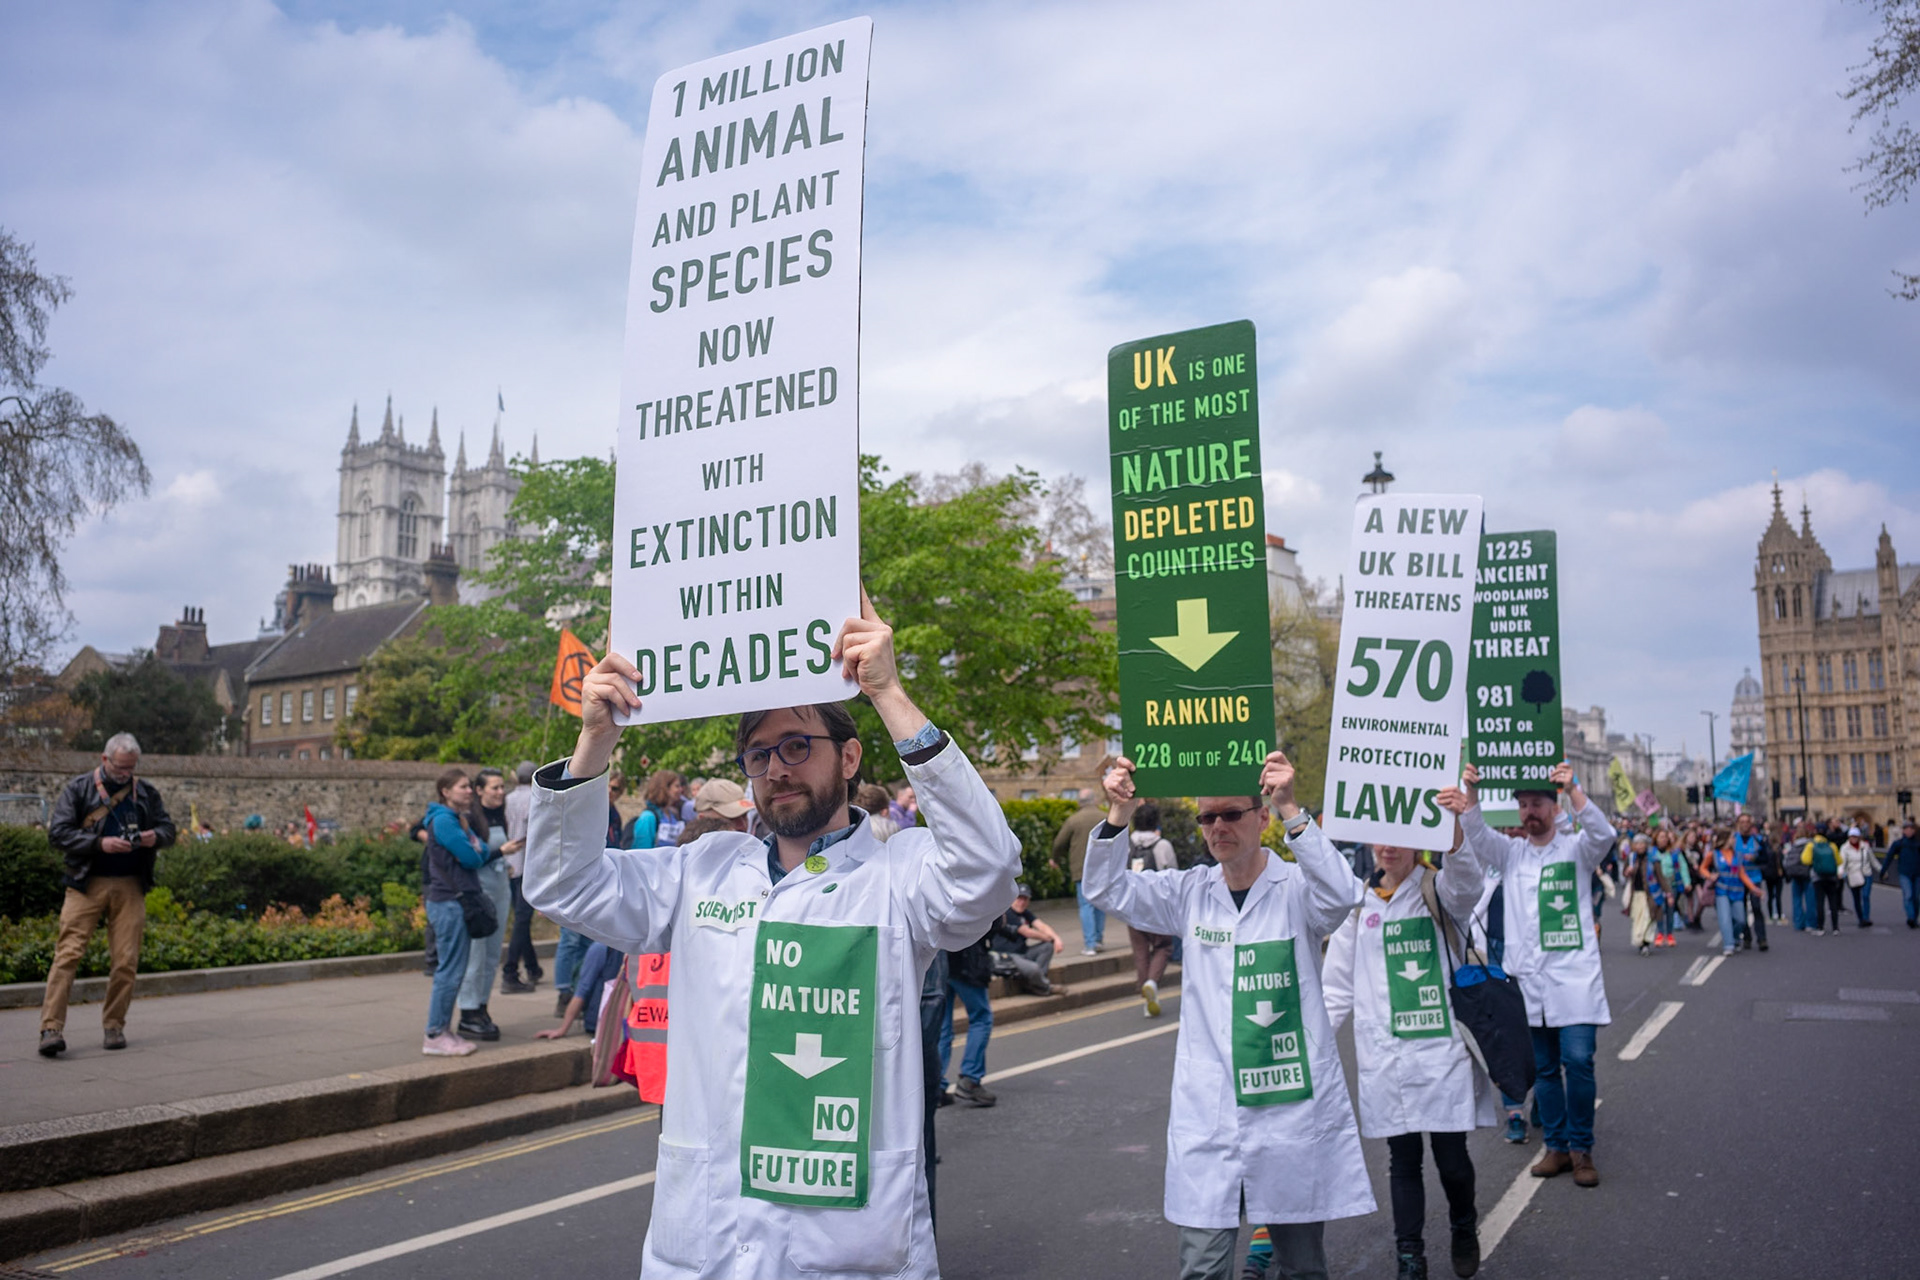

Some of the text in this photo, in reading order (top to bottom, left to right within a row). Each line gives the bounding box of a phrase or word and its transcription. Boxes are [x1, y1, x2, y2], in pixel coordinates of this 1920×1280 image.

[672, 39, 845, 118] 1 MILLION
[656, 96, 844, 188] ANIMAL
[651, 170, 840, 248] AND PLANT
[650, 229, 833, 313] SPECIES
[698, 316, 774, 368] NOW
[1134, 346, 1246, 390] UK IS ONE
[636, 366, 838, 440] THREATENED
[1119, 389, 1250, 431] OF THE MOST
[702, 453, 764, 491] WITH
[1122, 439, 1252, 495] NATURE
[630, 495, 837, 569] EXTINCTION
[1124, 496, 1255, 541] DEPLETED
[1364, 507, 1469, 535] A NEW
[1127, 541, 1255, 580] COUNTRIES
[1358, 551, 1464, 579] UK BILL
[1486, 540, 1533, 562] 1225
[1475, 563, 1549, 585] ANCIENT
[680, 572, 783, 620] WITHIN
[1354, 590, 1462, 613] THREATENS
[1492, 604, 1528, 618] IN UK
[1490, 620, 1532, 634] UNDER
[636, 619, 832, 697] DECADES
[1473, 636, 1551, 659] THREAT
[1346, 636, 1454, 702] 570
[1476, 685, 1514, 707] 981
[1145, 695, 1250, 726] RANKING
[1341, 716, 1449, 737] ENVIRONMENTAL
[1476, 717, 1533, 733] LOST OR
[1135, 739, 1267, 768] 228 OUT OF 240
[1338, 746, 1446, 771] PROTECTION
[1476, 740, 1555, 758] DAMAGED
[1477, 765, 1517, 780] SINCE
[1334, 780, 1442, 828] LAWS
[1541, 880, 1573, 891] NATURE
[1542, 867, 1555, 878] NO
[1385, 923, 1402, 937] NO
[766, 939, 803, 968] NO
[1238, 949, 1256, 967] NO
[1387, 939, 1432, 956] NATURE
[1237, 971, 1291, 992] NATURE
[1421, 989, 1438, 1002] NO
[761, 983, 861, 1015] NATURE
[1396, 1012, 1443, 1027] FUTURE
[1274, 1036, 1295, 1054] NO
[1241, 1066, 1302, 1089] FUTURE
[816, 1103, 855, 1132] NO
[752, 1153, 853, 1187] FUTURE
